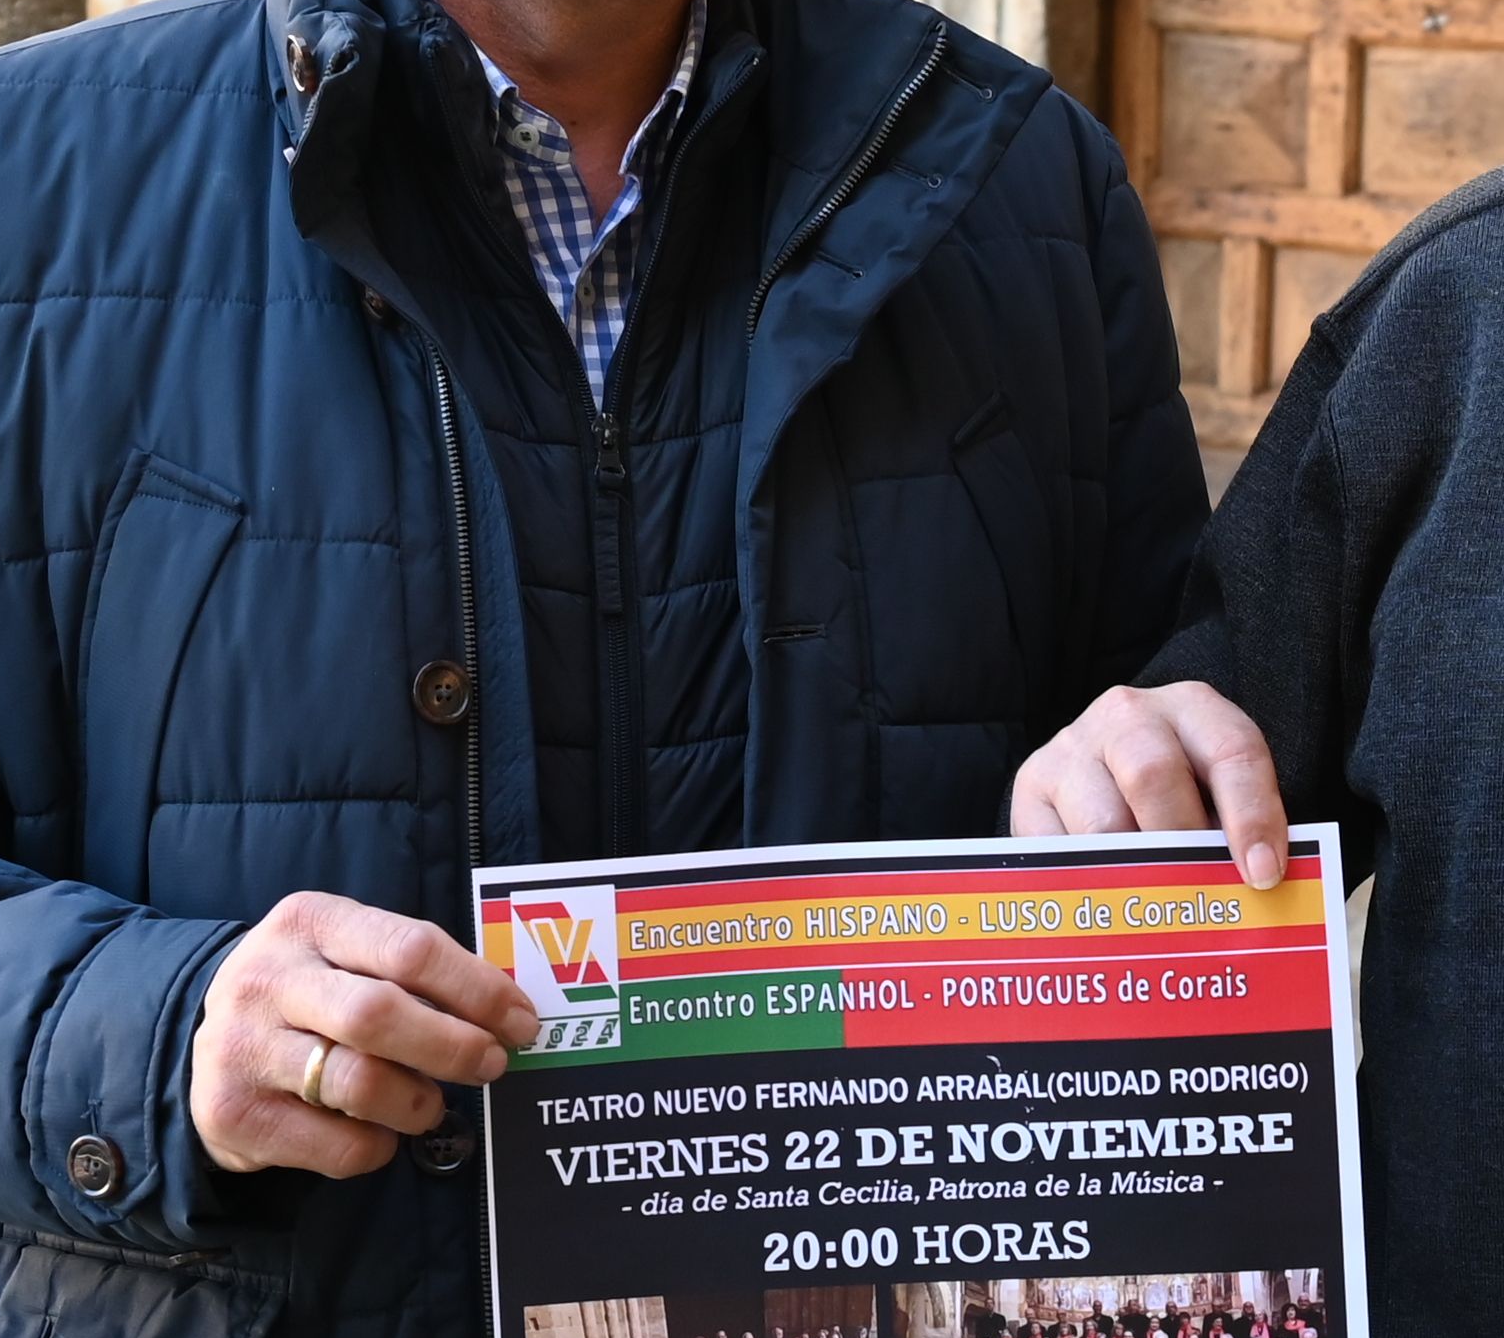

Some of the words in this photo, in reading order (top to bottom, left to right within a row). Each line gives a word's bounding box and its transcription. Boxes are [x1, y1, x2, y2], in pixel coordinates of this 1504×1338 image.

[630, 914, 792, 950] Encuentro
[806, 903, 947, 937] HISPANO
[980, 900, 1061, 931] LUSO
[1075, 897, 1110, 929] de
[1124, 893, 1240, 926] Corales
[629, 990, 755, 1024] Encontro
[766, 979, 915, 1015] ESPANHOL
[942, 973, 1107, 1007] PORTUGUES
[1117, 970, 1150, 1002] de
[1160, 966, 1247, 1000] Corais
[518, 1018, 618, 1051] 024
[538, 1093, 644, 1125] TEATRO
[654, 1086, 746, 1115] NUEVO
[756, 1078, 908, 1109] FERNANDO
[1170, 1063, 1308, 1093] RODRIGO)
[546, 1134, 769, 1185] VIERNES
[785, 1130, 840, 1170] 22
[855, 1126, 933, 1166] DE
[948, 1113, 1294, 1163] NOVIEMBRE
[641, 1192, 683, 1215] día
[693, 1189, 727, 1212] de
[735, 1186, 809, 1209] Santa
[819, 1179, 920, 1205] Cecilia,
[927, 1178, 1026, 1200] Patrona
[1035, 1174, 1070, 1196] de
[1077, 1173, 1101, 1195] la
[1110, 1170, 1204, 1194] Música
[764, 1228, 898, 1271] 20:00
[913, 1221, 1090, 1264] HORAS
